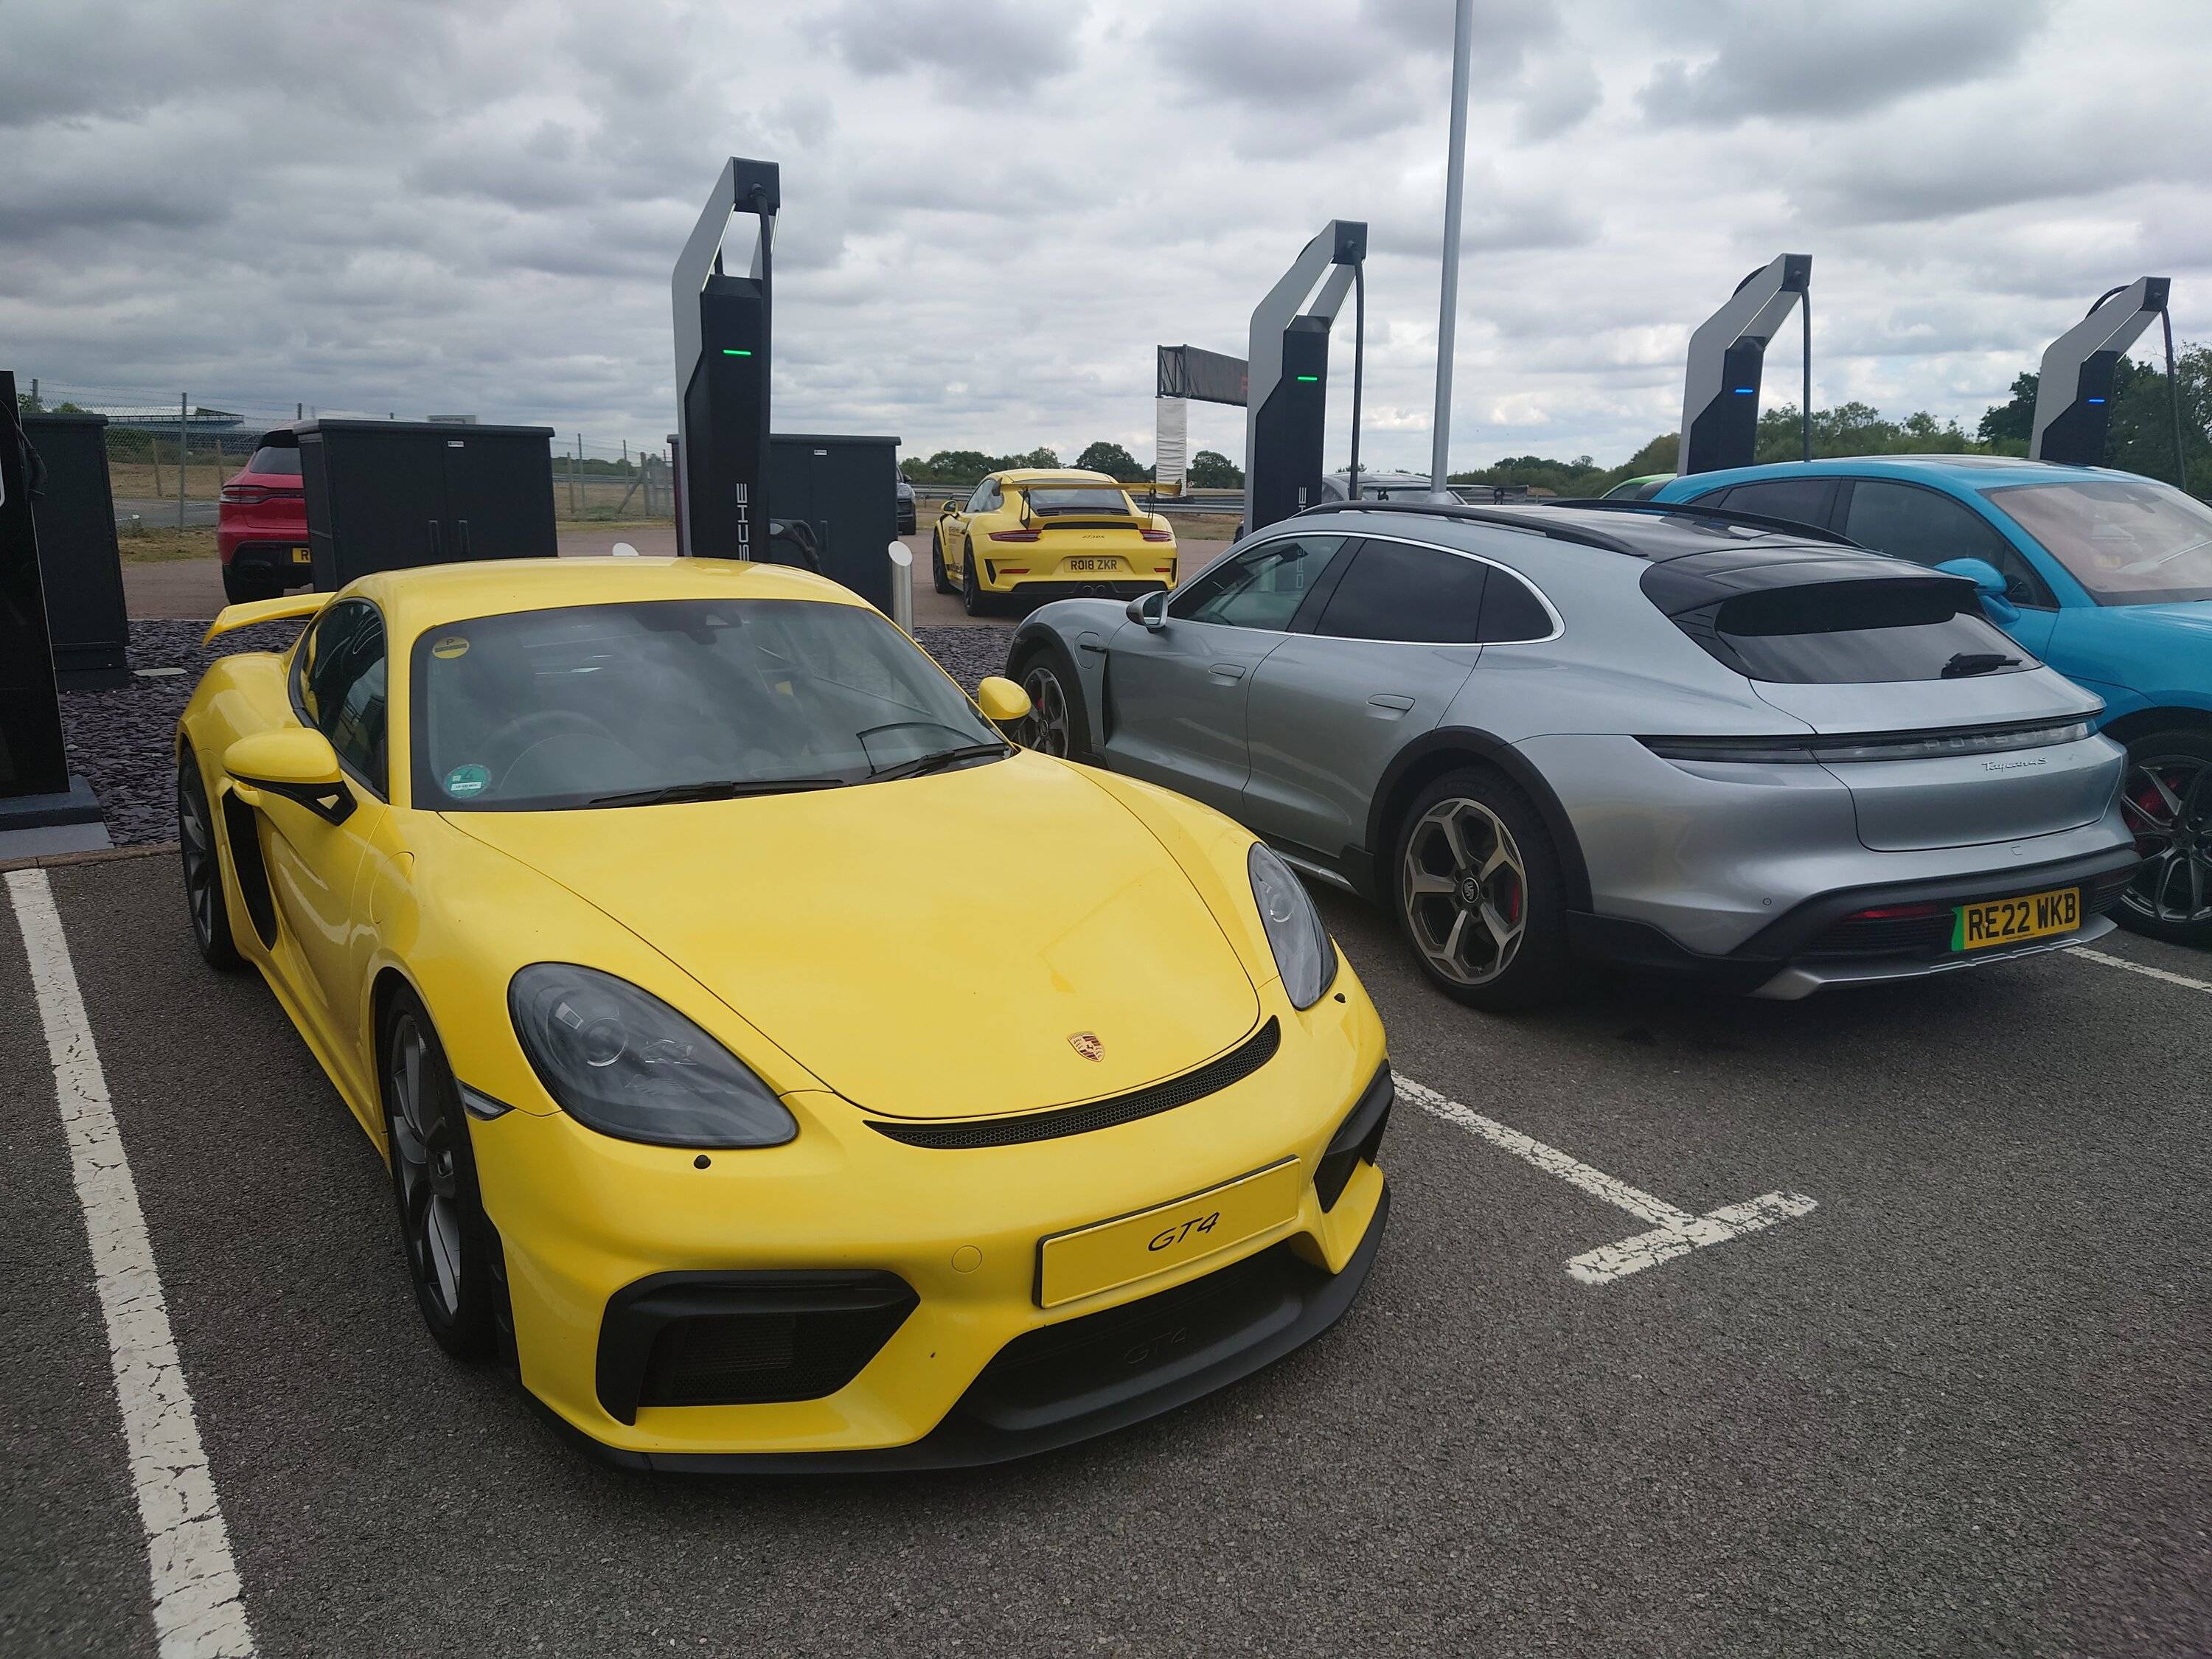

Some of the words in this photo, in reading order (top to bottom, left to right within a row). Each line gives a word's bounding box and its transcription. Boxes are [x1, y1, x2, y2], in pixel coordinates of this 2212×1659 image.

[737, 483, 749, 561] SCHE
[1097, 560, 1117, 570] ZKR
[1969, 901, 2030, 941] RE22
[2037, 893, 2076, 929] WKB
[1148, 1211, 1220, 1251] GT4
